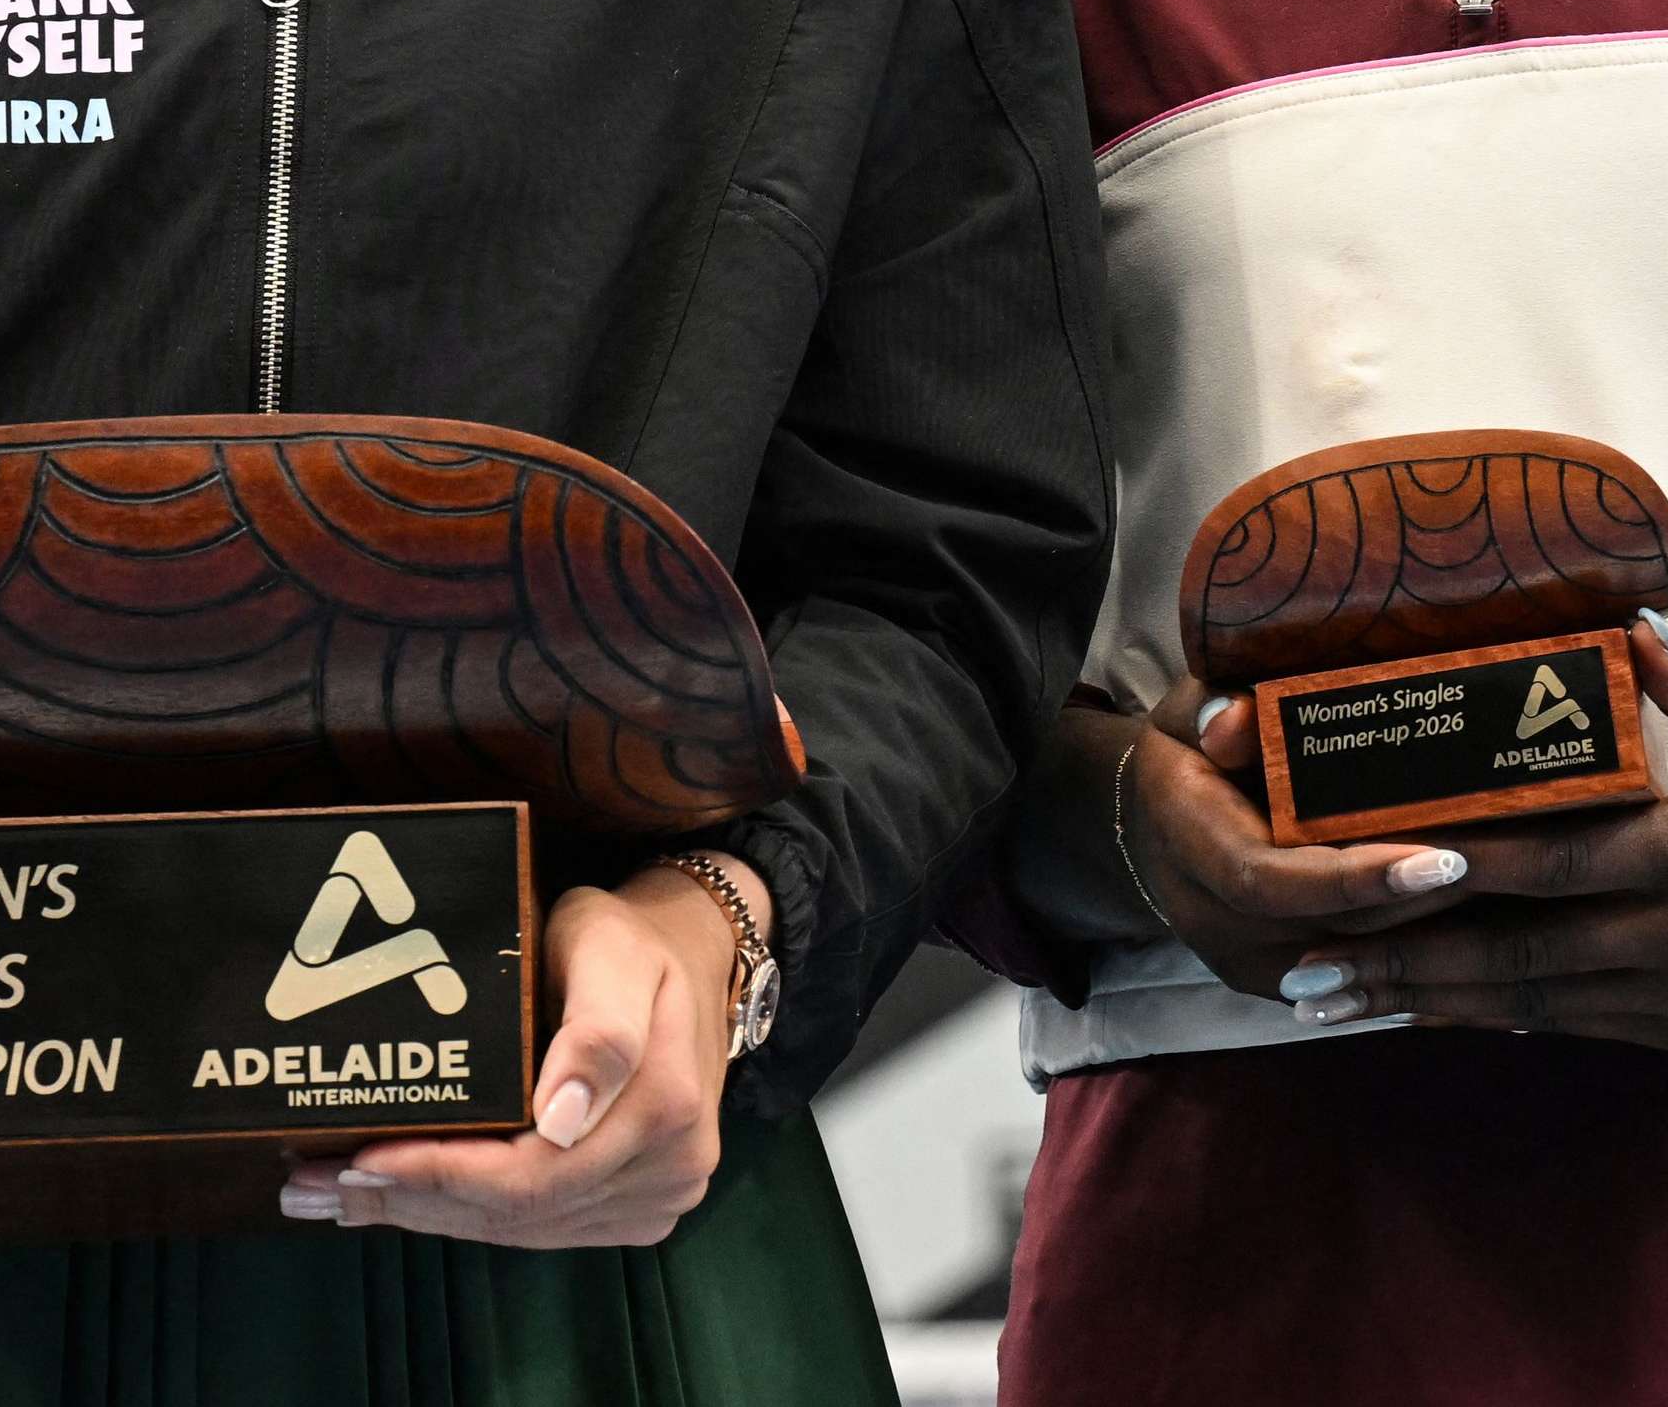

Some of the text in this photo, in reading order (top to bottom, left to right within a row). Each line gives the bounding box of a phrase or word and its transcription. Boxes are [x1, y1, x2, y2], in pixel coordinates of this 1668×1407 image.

[1298, 682, 1464, 726] Women's Singles
[1303, 712, 1464, 757] Runner-up 2026
[1493, 738, 1595, 768] ADELAIDE
[1529, 755, 1596, 771] INTERNATIONAL
[193, 1039, 471, 1088] ADELAIDE
[288, 1084, 471, 1108] INTERNATIONAL
